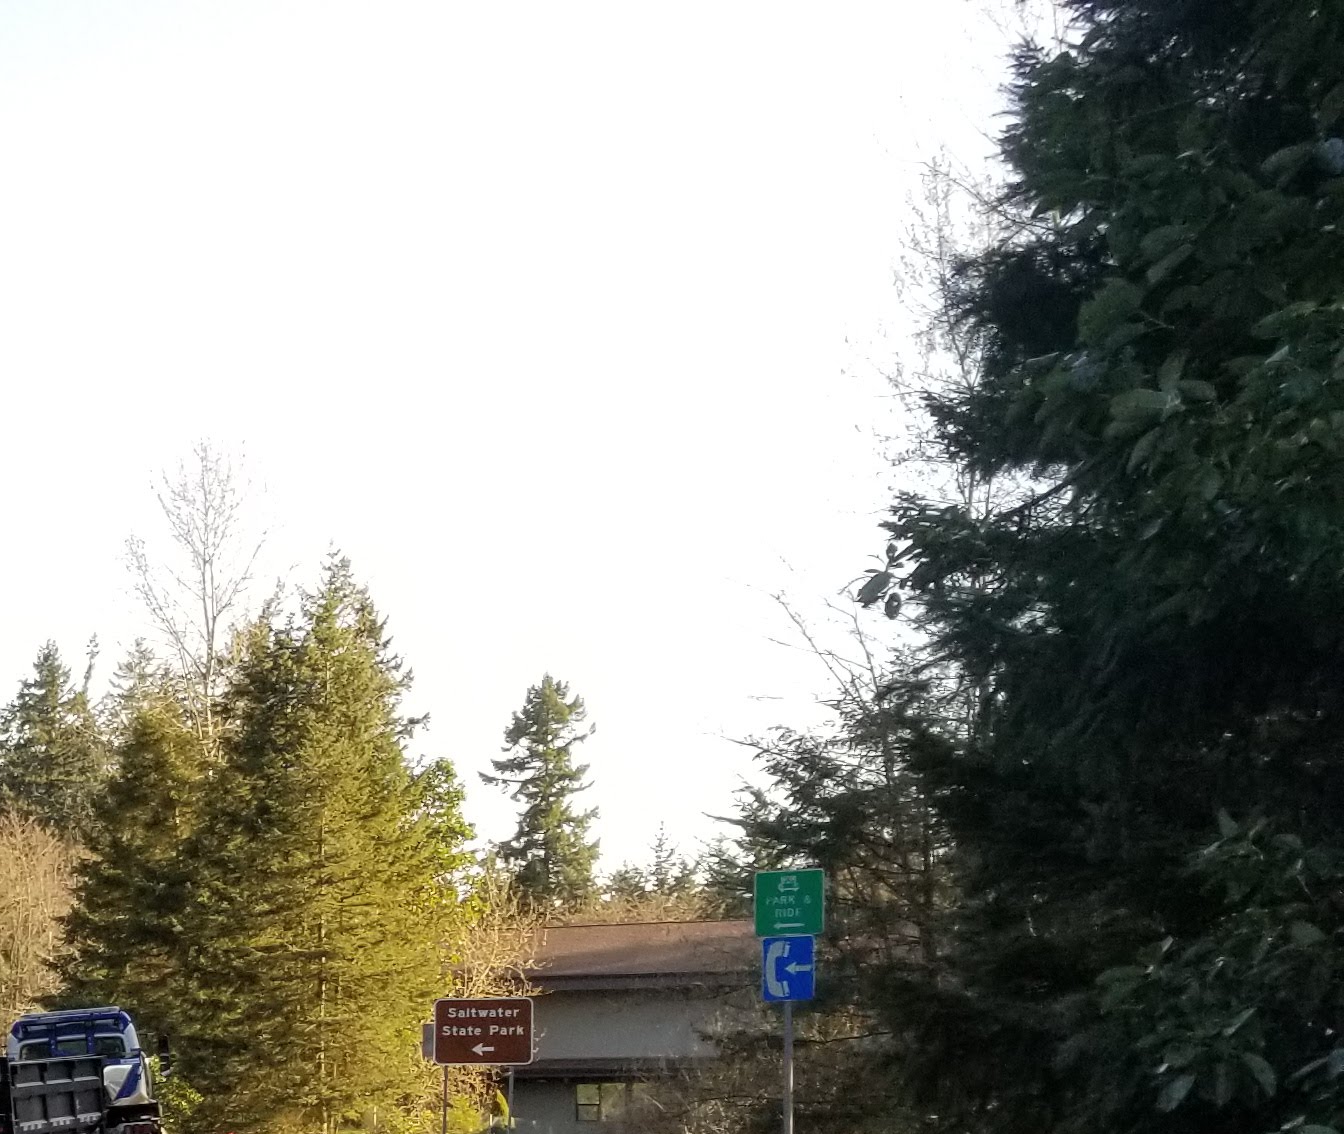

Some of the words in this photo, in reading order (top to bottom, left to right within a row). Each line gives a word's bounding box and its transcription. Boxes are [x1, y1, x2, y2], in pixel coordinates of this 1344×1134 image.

[447, 1007, 520, 1018] Saltwater
[442, 1025, 482, 1036] State
[489, 1025, 525, 1036] Park
